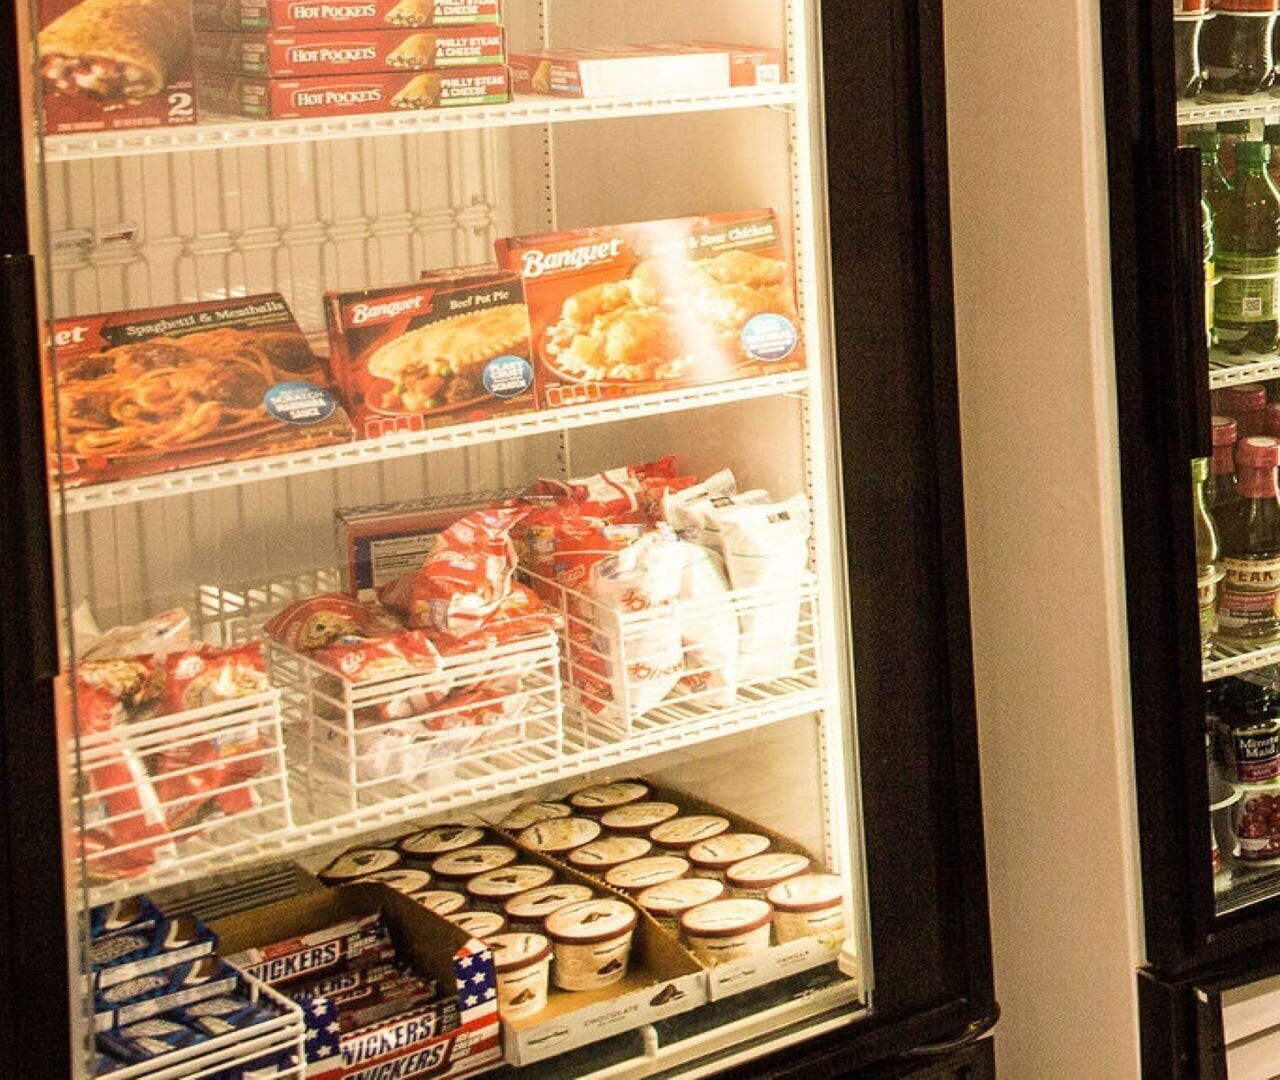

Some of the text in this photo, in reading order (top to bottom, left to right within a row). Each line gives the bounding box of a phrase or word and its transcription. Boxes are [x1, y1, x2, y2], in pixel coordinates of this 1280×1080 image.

[293, 3, 377, 18] HOT POCKETS
[291, 45, 377, 63] HOT POCKETS
[168, 93, 194, 117] 2
[297, 88, 382, 106] HOT POCKETS
[728, 223, 774, 242] Chicken
[522, 237, 626, 278] Banquet
[352, 294, 428, 324] Banquet
[449, 290, 510, 311] Beef Pot Pie
[125, 300, 287, 336] Spaghetti & Meatballs
[1226, 569, 1274, 582] PEAK
[247, 942, 338, 982] NICKERS
[340, 1014, 434, 1065] NICKERS
